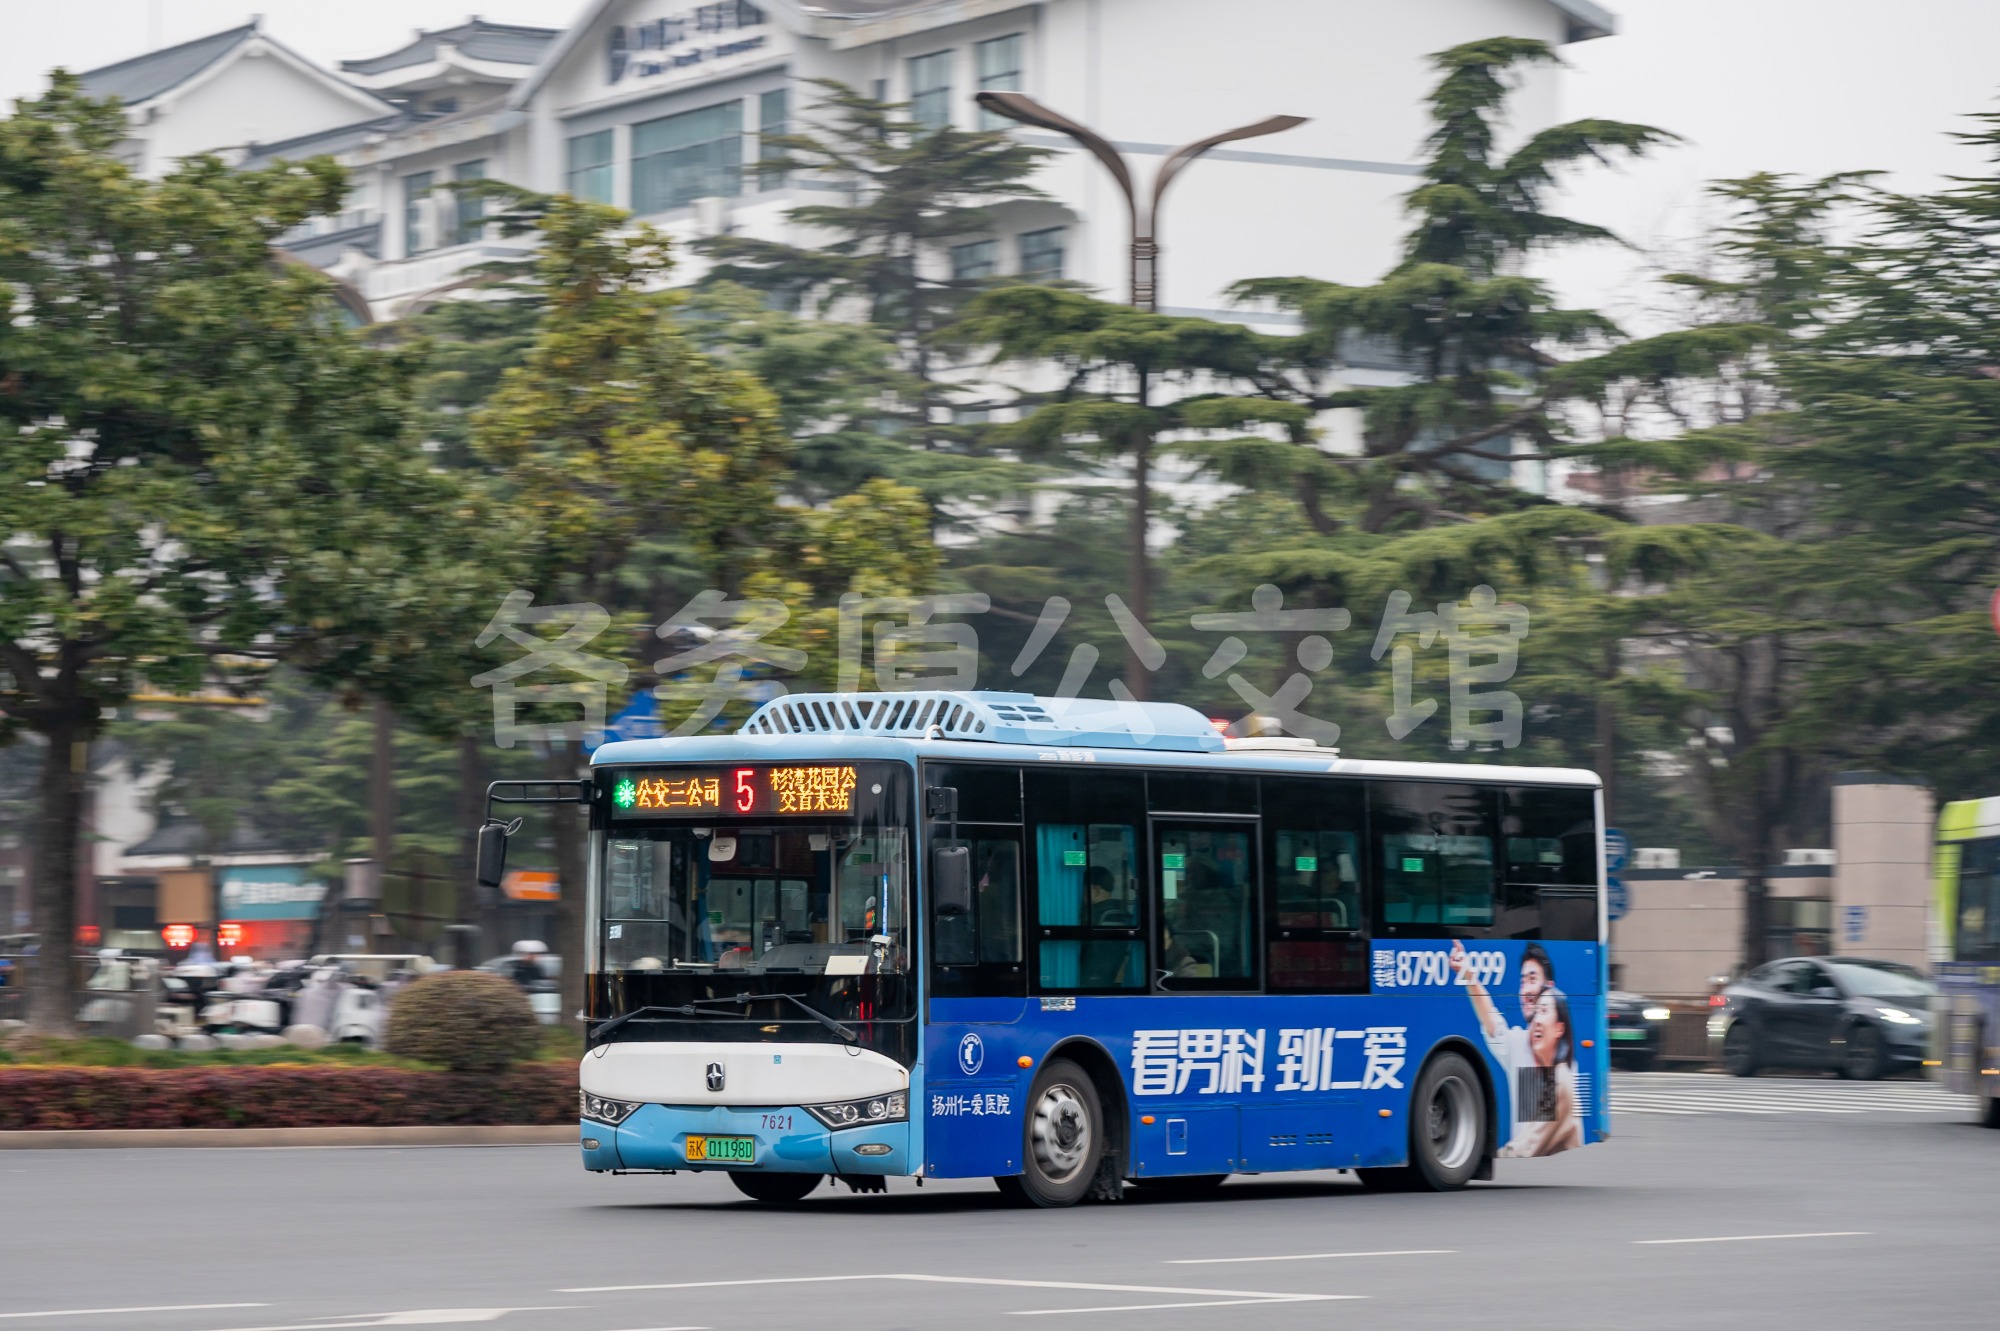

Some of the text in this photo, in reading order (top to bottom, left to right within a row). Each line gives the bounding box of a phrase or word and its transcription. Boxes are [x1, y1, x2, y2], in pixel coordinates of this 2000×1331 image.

[770, 766, 857, 790] 杉湾花园公
[636, 778, 720, 808] 公交三公司
[736, 770, 754, 812] 5
[779, 788, 849, 812] 交首末站
[1131, 1026, 1408, 1096] 看男科 到仁爱
[931, 1093, 1012, 1117] 扬州仁爱医院
[761, 1114, 793, 1130] 7621
